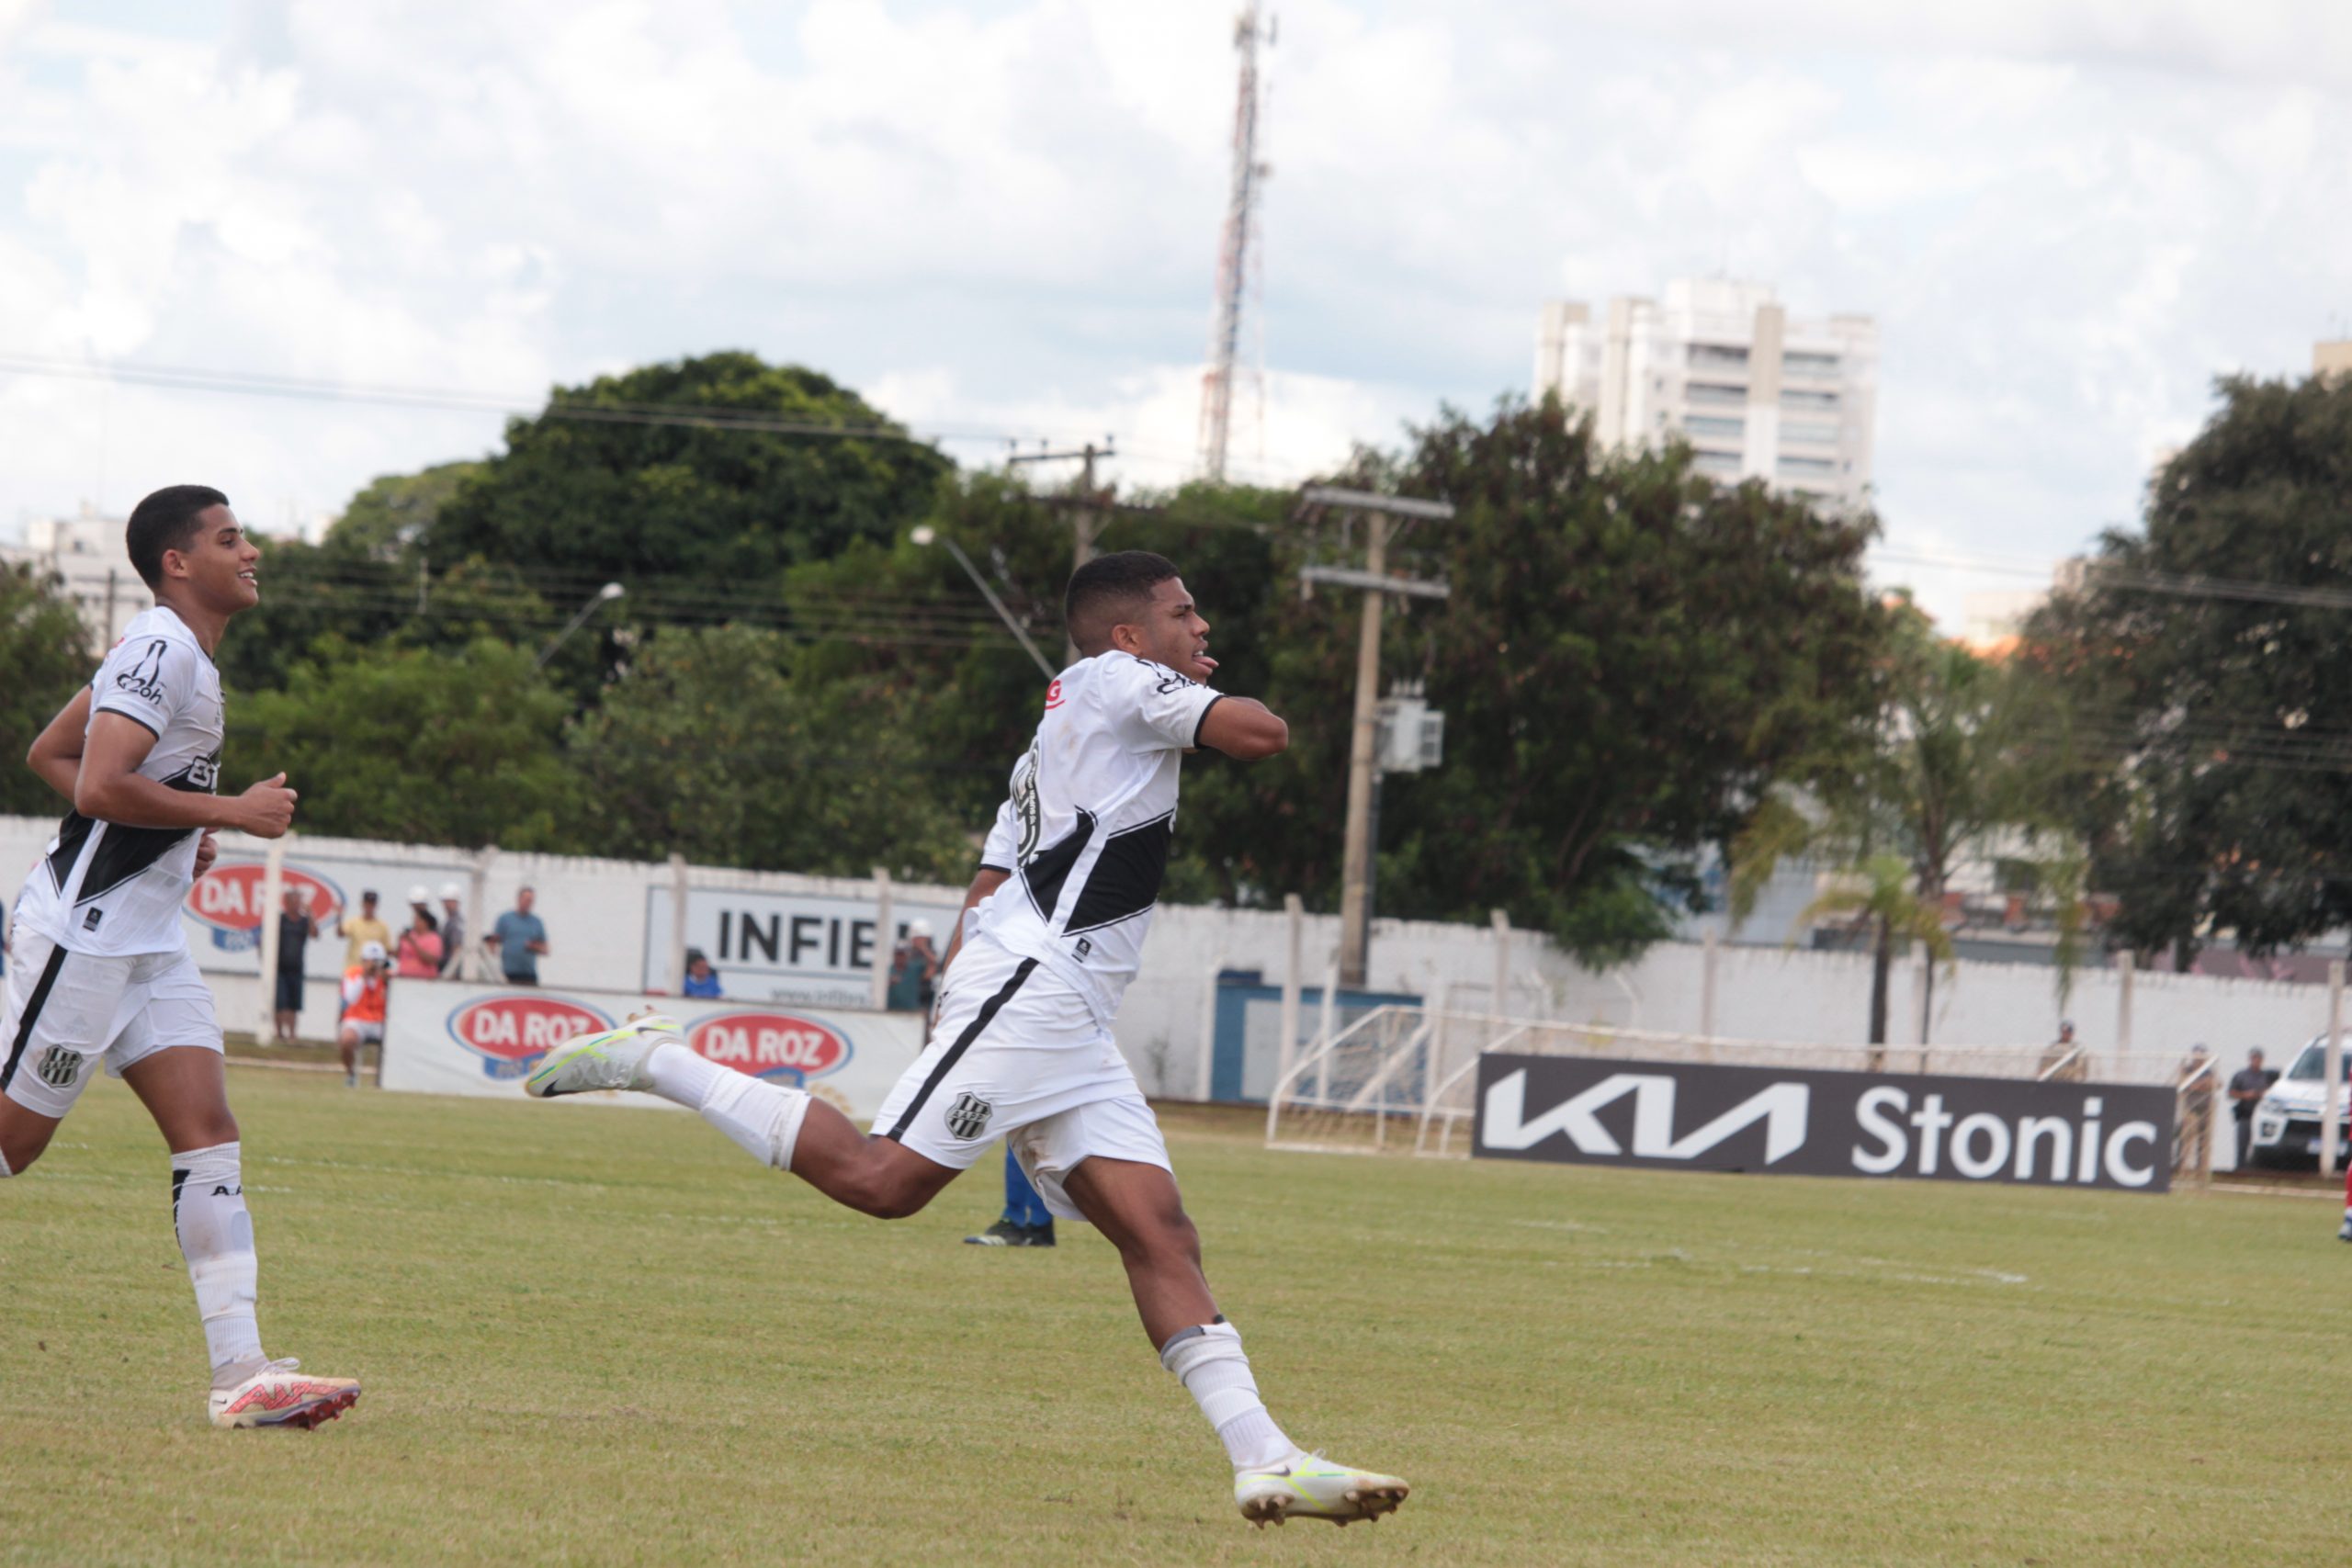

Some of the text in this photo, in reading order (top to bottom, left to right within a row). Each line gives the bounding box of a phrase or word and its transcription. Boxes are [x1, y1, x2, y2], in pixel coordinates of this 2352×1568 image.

[199, 876, 247, 916] DA
[473, 1009, 518, 1045] DA
[706, 1024, 824, 1066] DA ROZ
[1482, 1067, 2157, 1187] KIA Stonic
